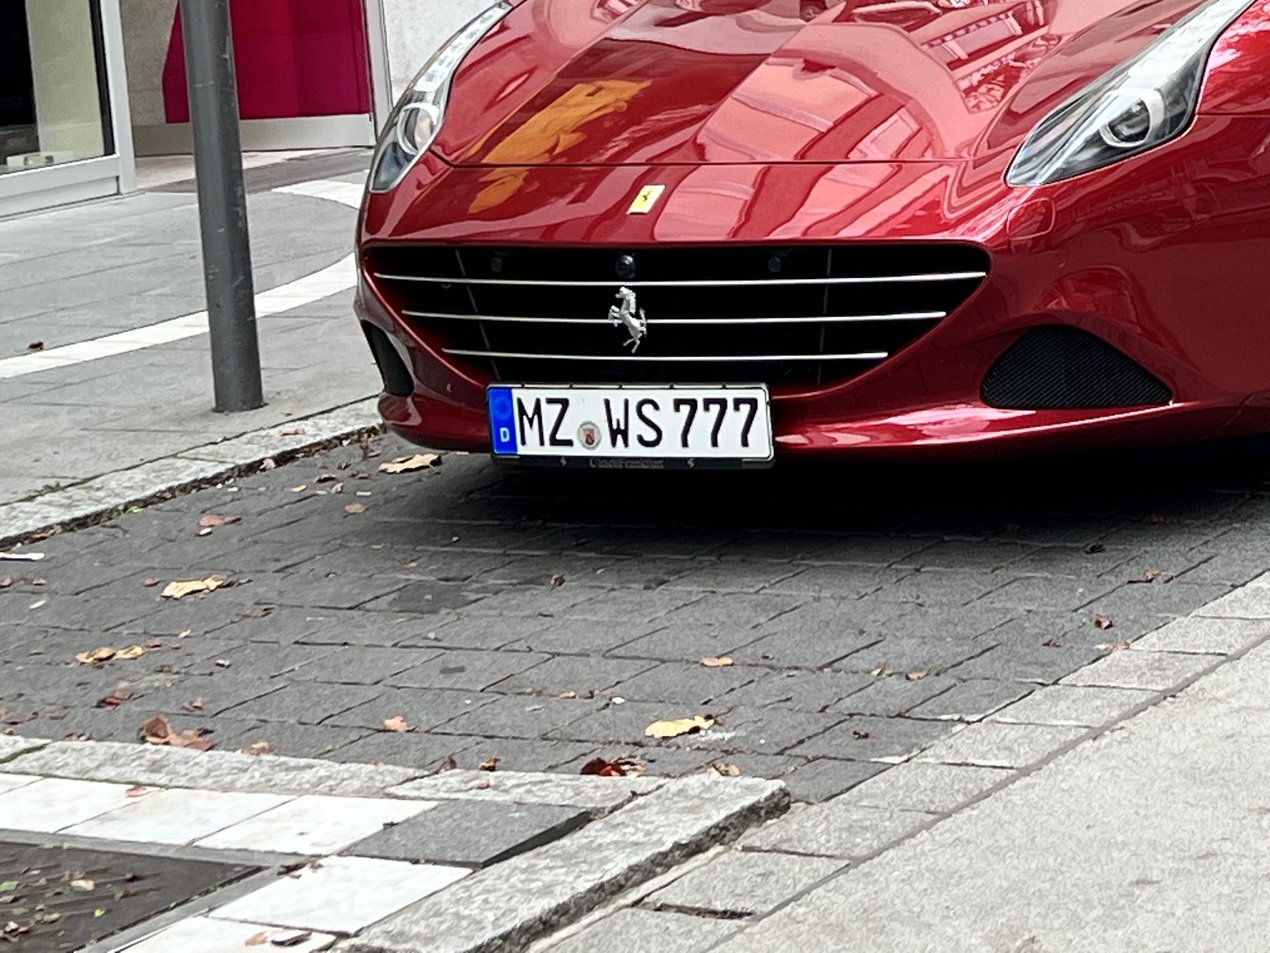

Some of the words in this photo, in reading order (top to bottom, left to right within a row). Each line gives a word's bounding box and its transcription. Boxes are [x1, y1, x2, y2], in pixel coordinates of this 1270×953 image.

[500, 427, 510, 443] D
[516, 397, 574, 447] MZ
[603, 397, 663, 448] WS
[673, 397, 758, 448] 777
